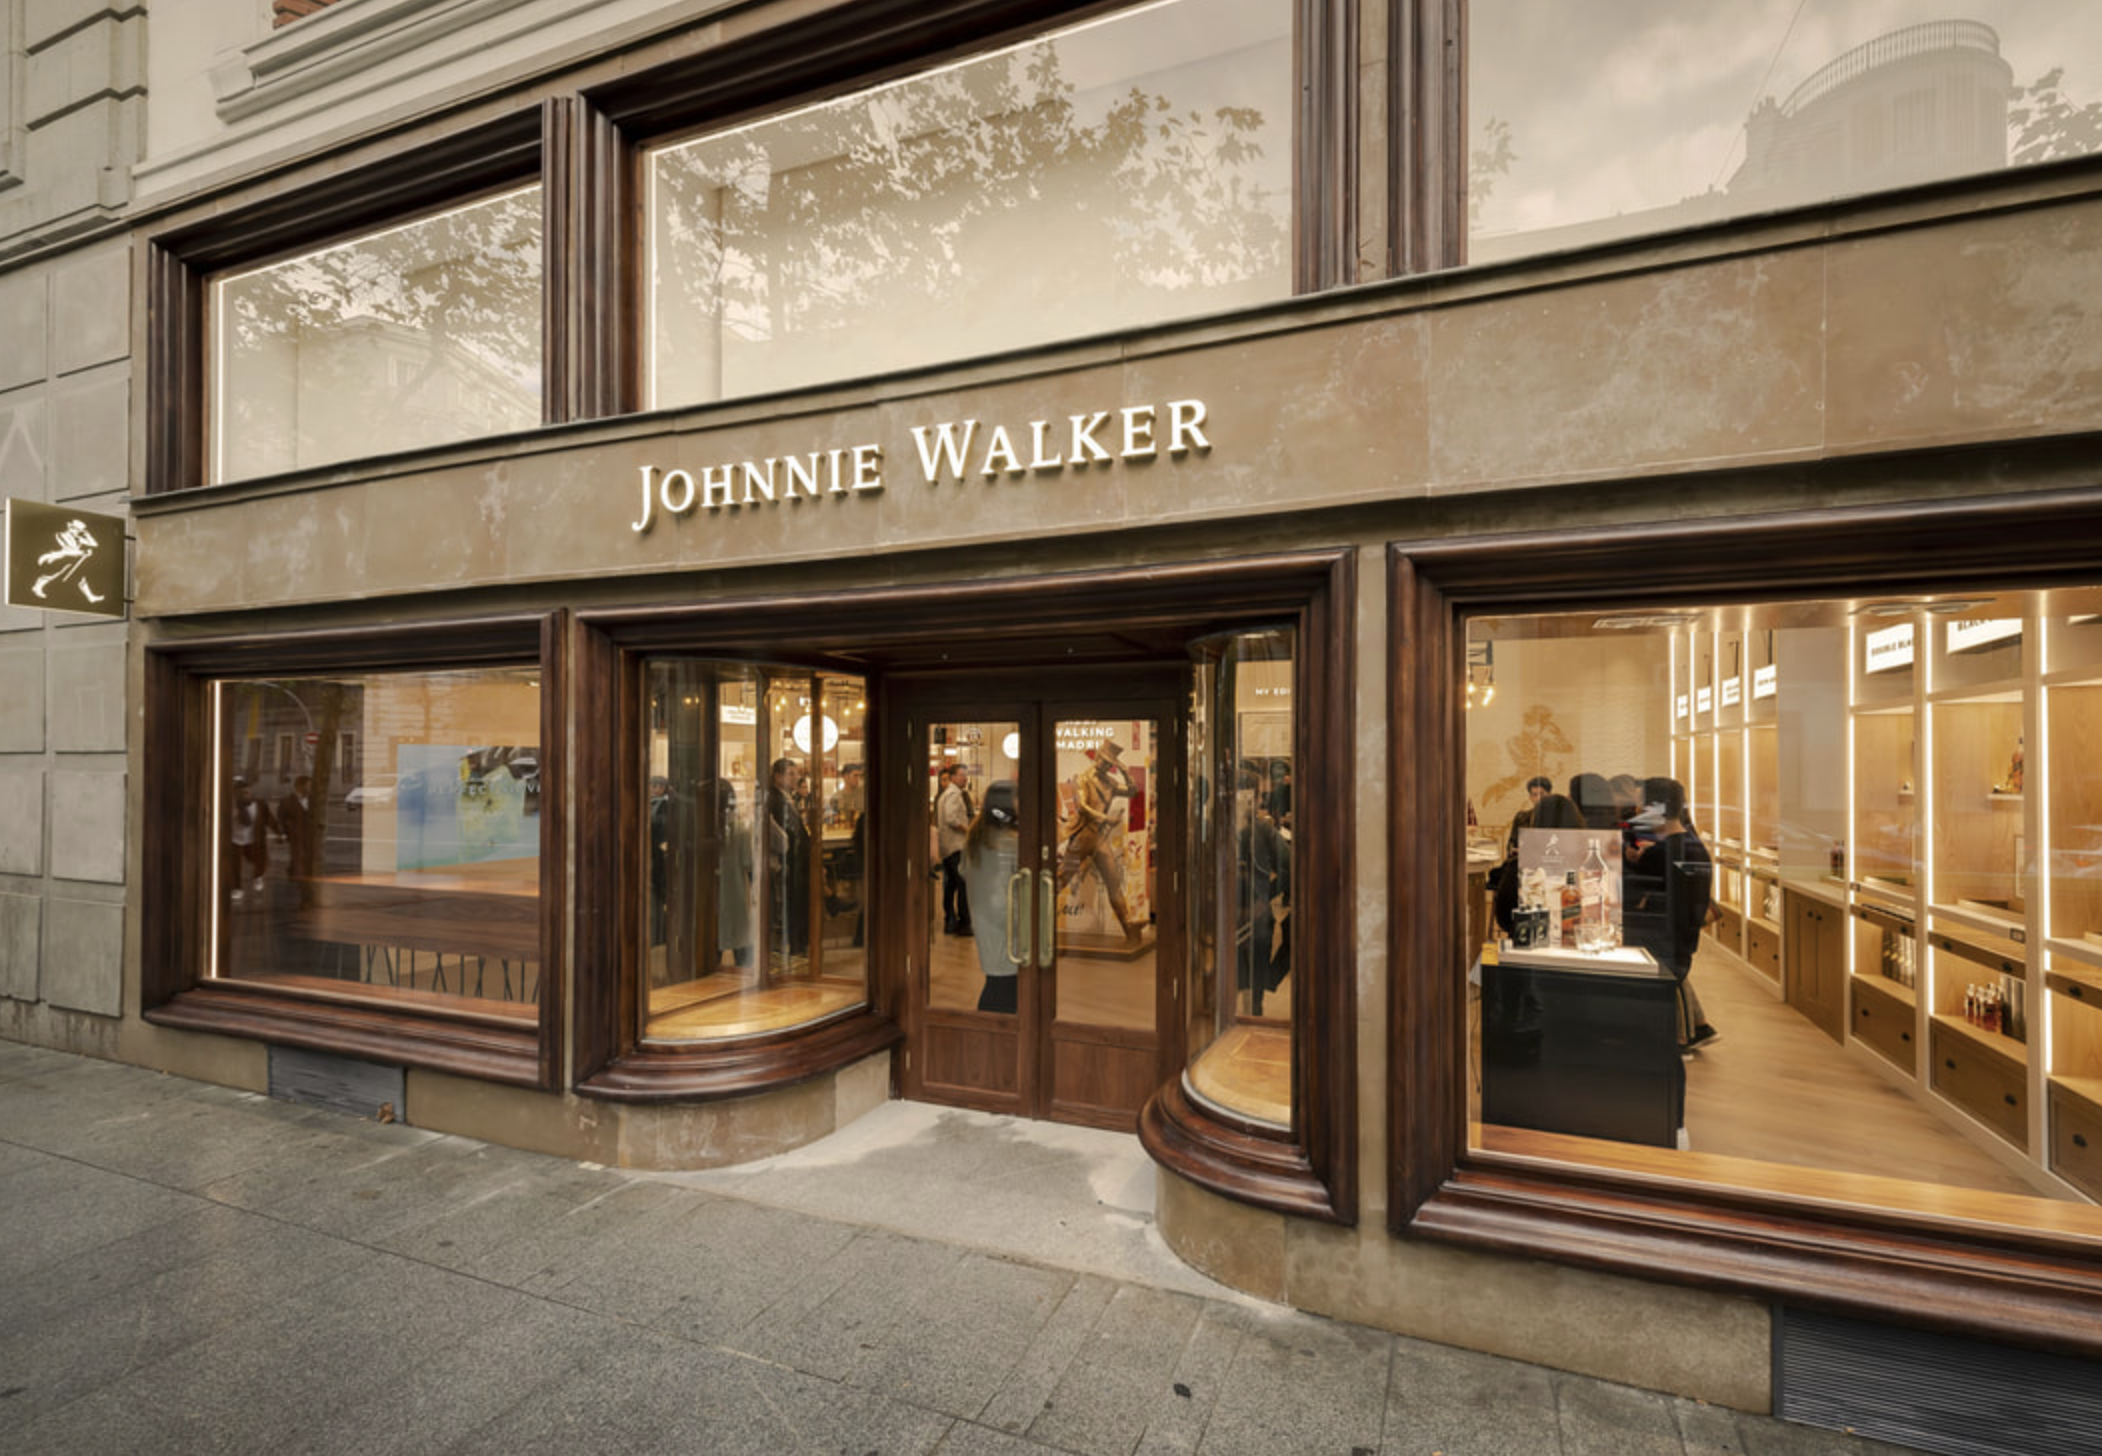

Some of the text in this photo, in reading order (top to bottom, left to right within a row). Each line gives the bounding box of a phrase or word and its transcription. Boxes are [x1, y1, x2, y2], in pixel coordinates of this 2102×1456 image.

[631, 399, 1211, 532] JOHNNIE WALKER
[1056, 740, 1104, 750] MADRI
